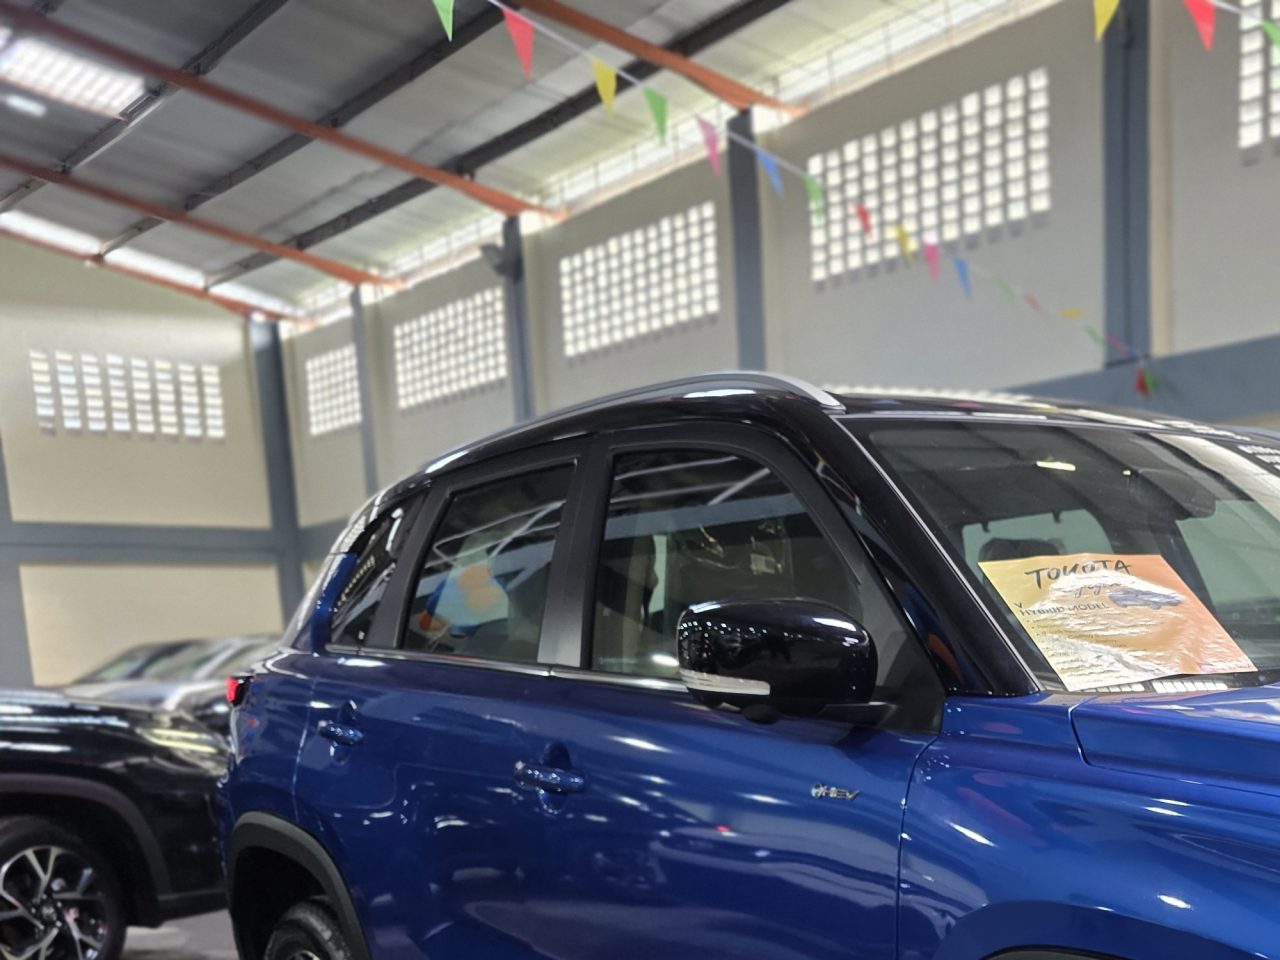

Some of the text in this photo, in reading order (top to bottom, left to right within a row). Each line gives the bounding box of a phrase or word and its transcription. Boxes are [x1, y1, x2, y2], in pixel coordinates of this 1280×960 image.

[1024, 560, 1131, 589] TOYOTA
[1019, 602, 1110, 616] HYBRID MODEL
